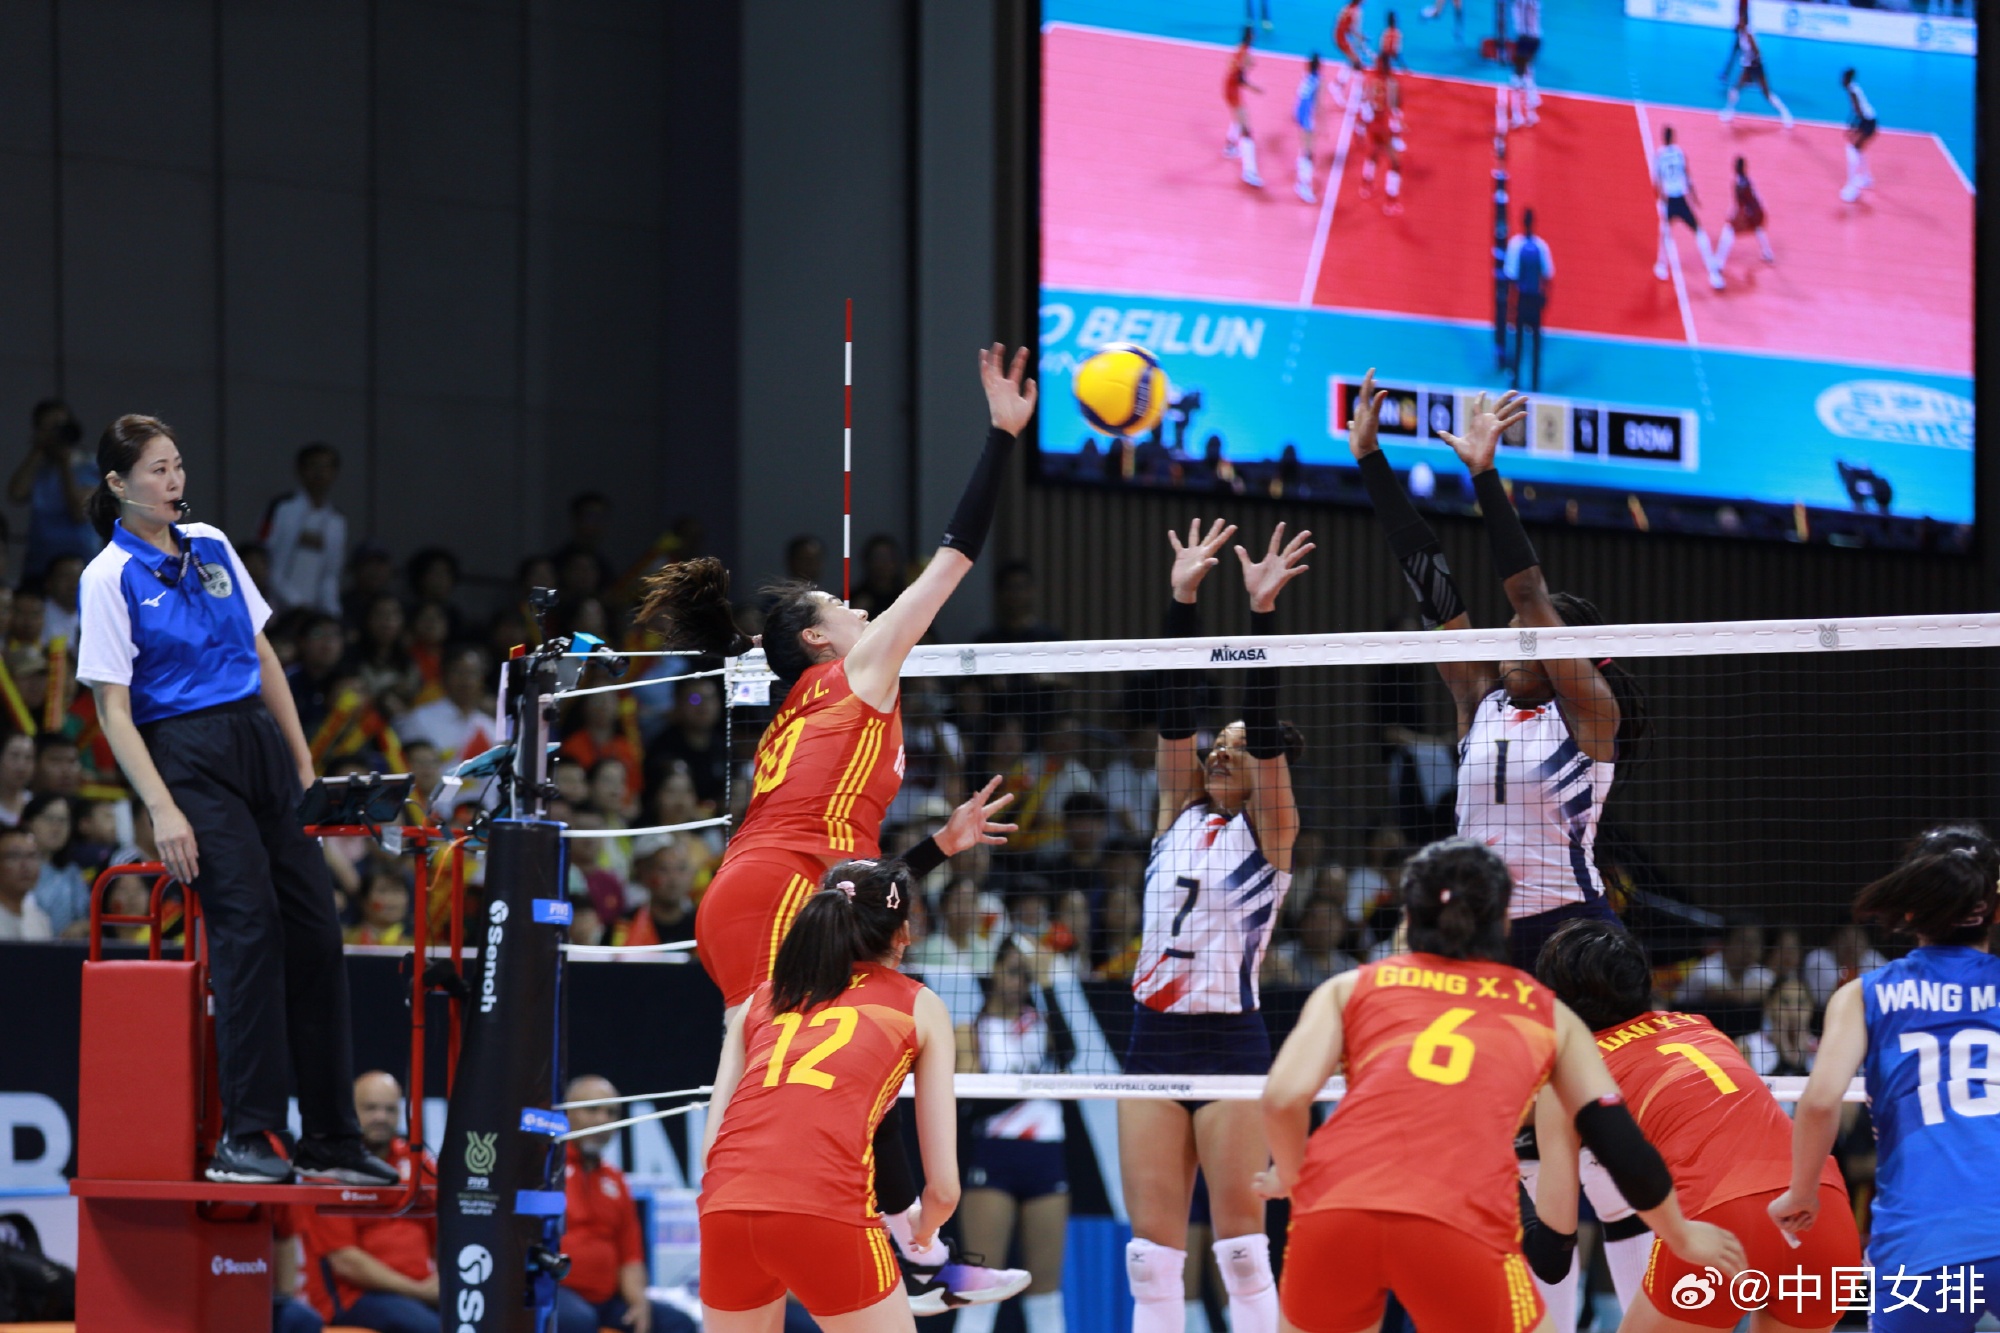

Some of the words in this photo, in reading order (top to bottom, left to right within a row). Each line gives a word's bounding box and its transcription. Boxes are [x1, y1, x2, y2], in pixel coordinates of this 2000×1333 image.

[1075, 306, 1265, 359] BEILUN
[1210, 644, 1266, 662] MIKASA
[1495, 739, 1509, 805] 1
[1172, 876, 1200, 937] 7
[480, 925, 503, 1012] Senoh
[1375, 965, 1468, 995] GONG
[1875, 979, 1963, 1015] WANG
[762, 1006, 859, 1090] 12
[1407, 1007, 1477, 1085] 6
[1596, 1021, 1659, 1059] UAN
[1094, 1082, 1146, 1091] VOLLEYBALL
[1148, 1082, 1192, 1091] QUALIFIER
[1655, 1042, 1740, 1095] 1
[1898, 1028, 2000, 1126] 18
[223, 1258, 267, 1275] Senoh
